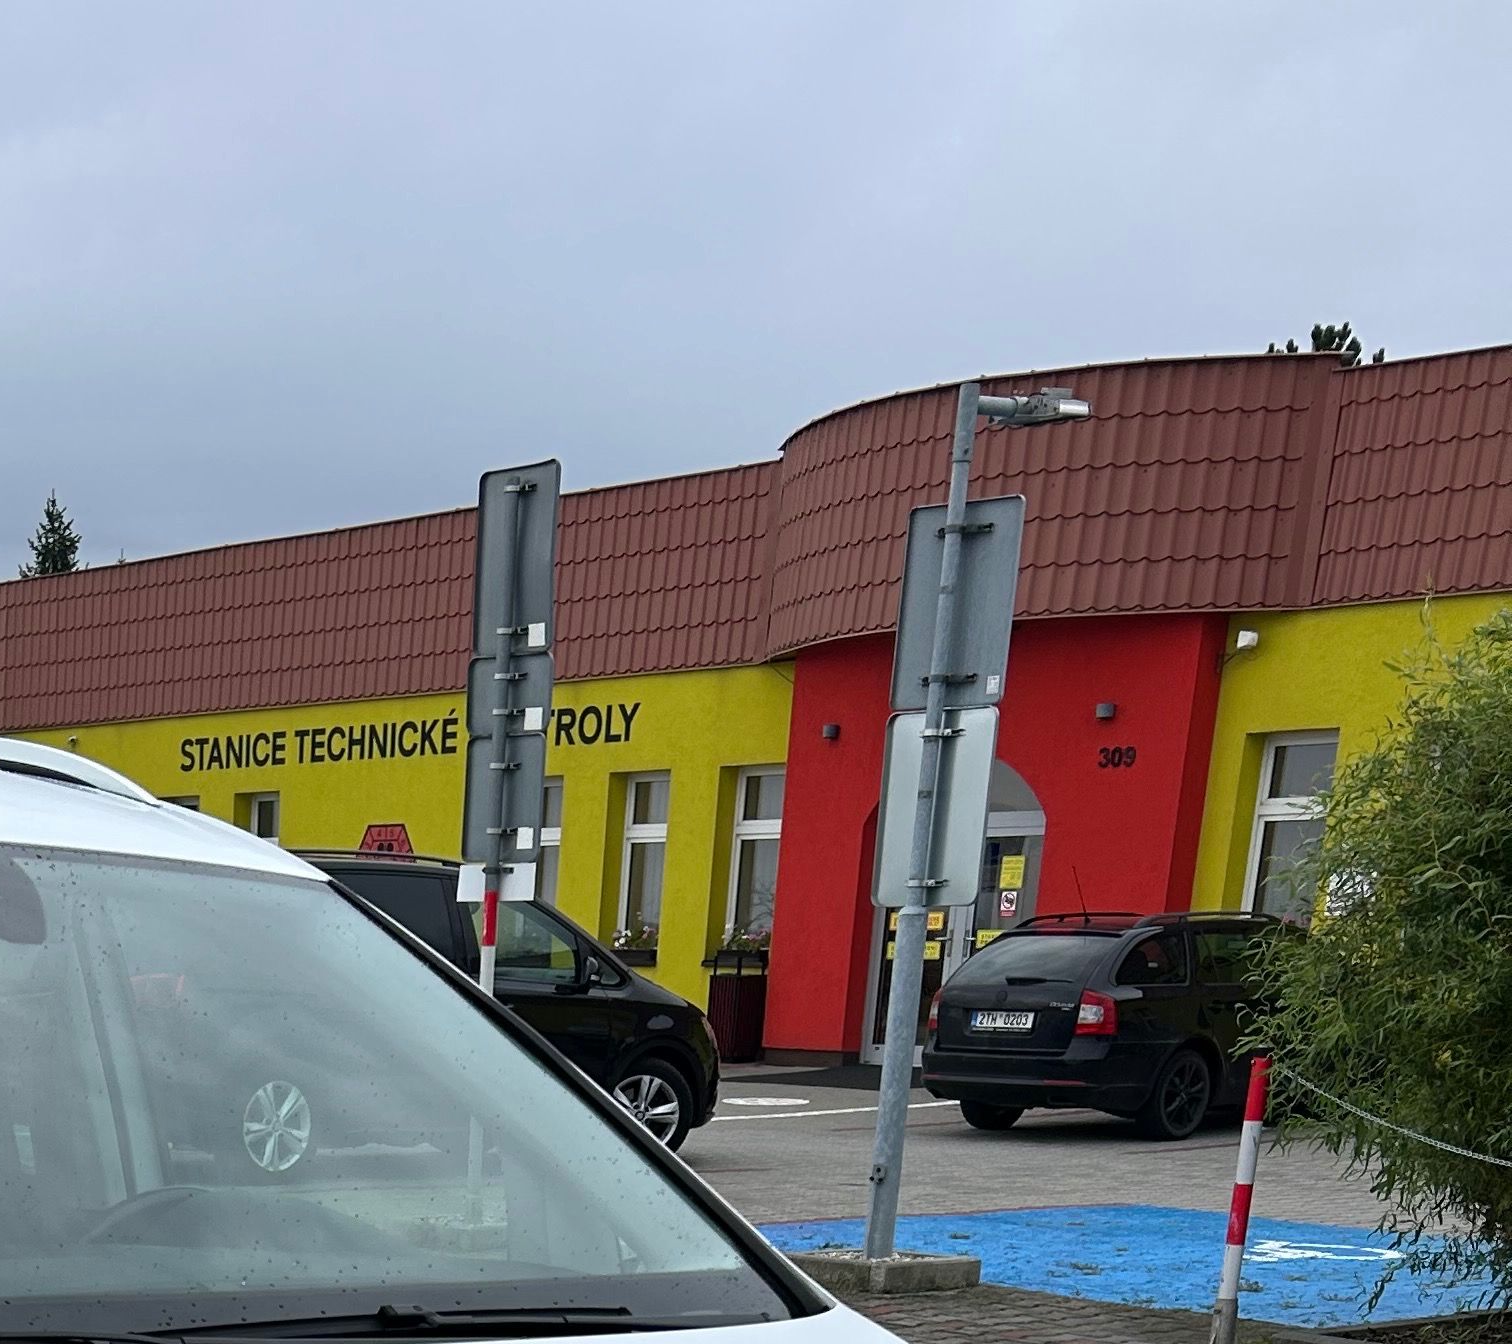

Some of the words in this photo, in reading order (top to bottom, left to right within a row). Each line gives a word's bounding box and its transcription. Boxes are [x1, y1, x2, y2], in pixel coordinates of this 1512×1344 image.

[179, 731, 287, 772] STANICE
[294, 708, 459, 764] TECHNICKÉ
[551, 702, 642, 747] ROLY
[1097, 745, 1137, 769] 309
[1003, 1013, 1029, 1027] 0203
